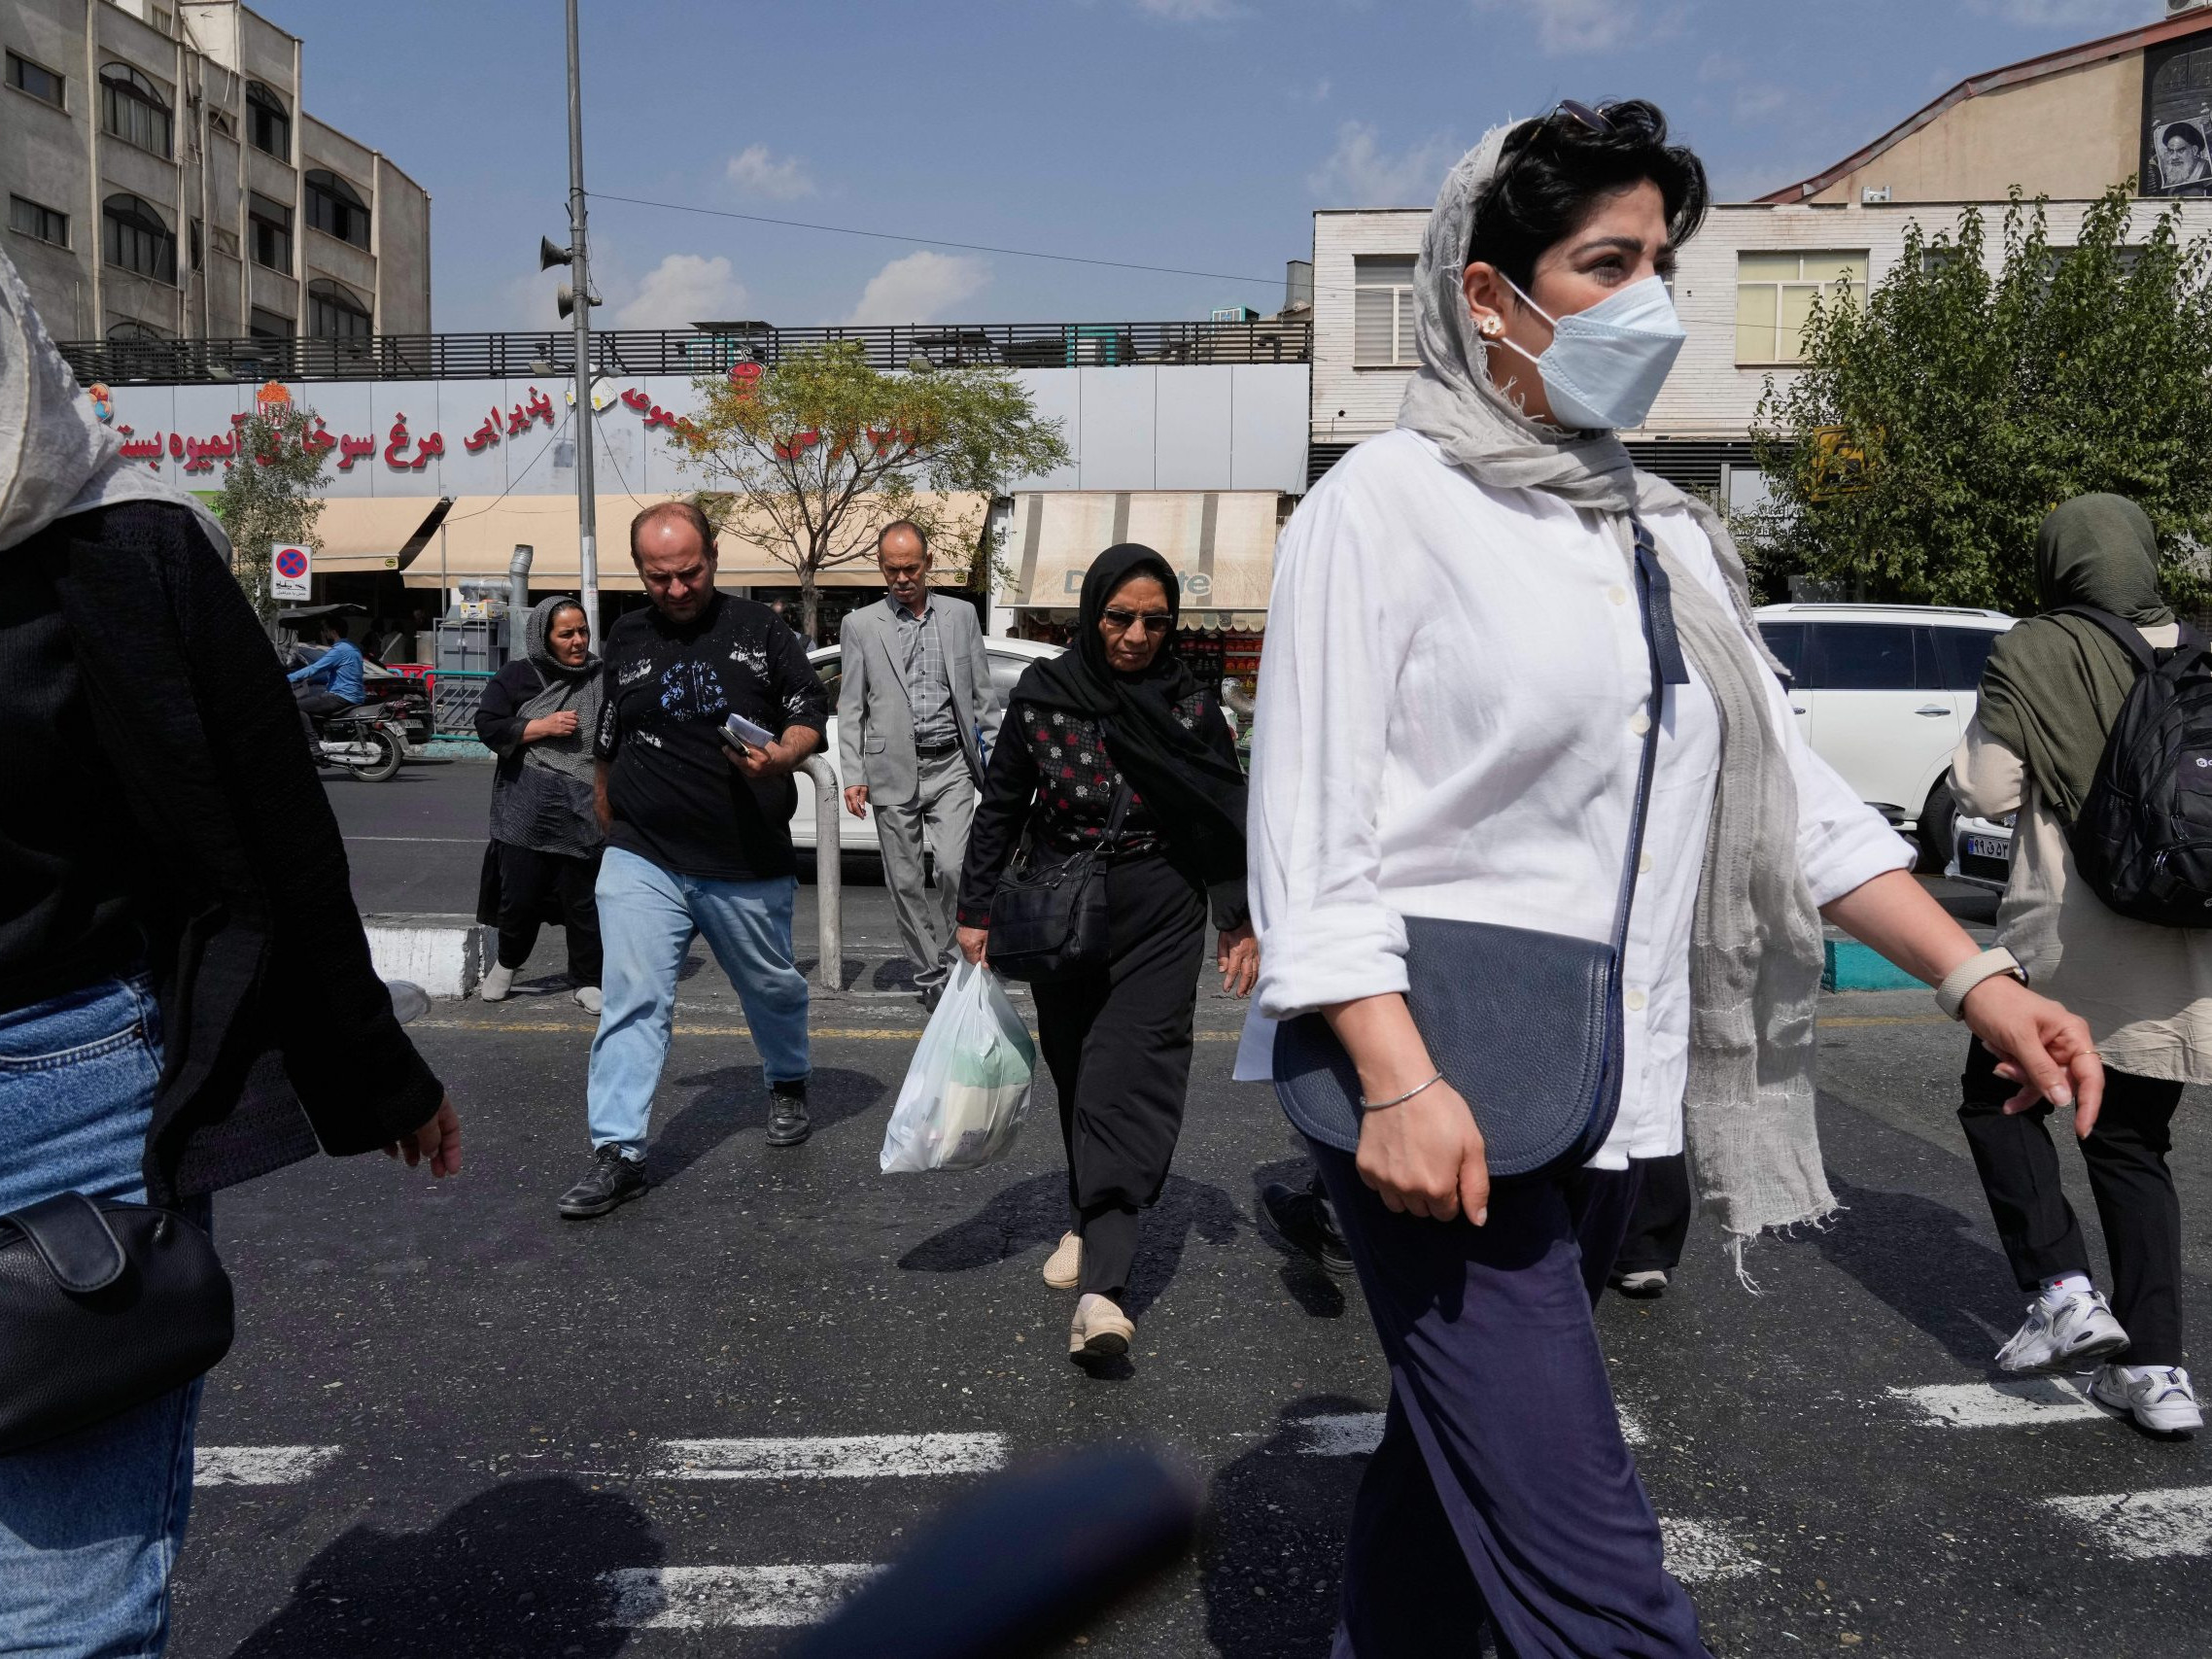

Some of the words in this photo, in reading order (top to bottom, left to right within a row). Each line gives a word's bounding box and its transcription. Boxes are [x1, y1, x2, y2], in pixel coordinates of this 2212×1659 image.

[169, 412, 247, 471] آبمیوه
[384, 412, 444, 467] مرغ
[464, 386, 555, 451] پذیرایی
[117, 425, 162, 470] بست
